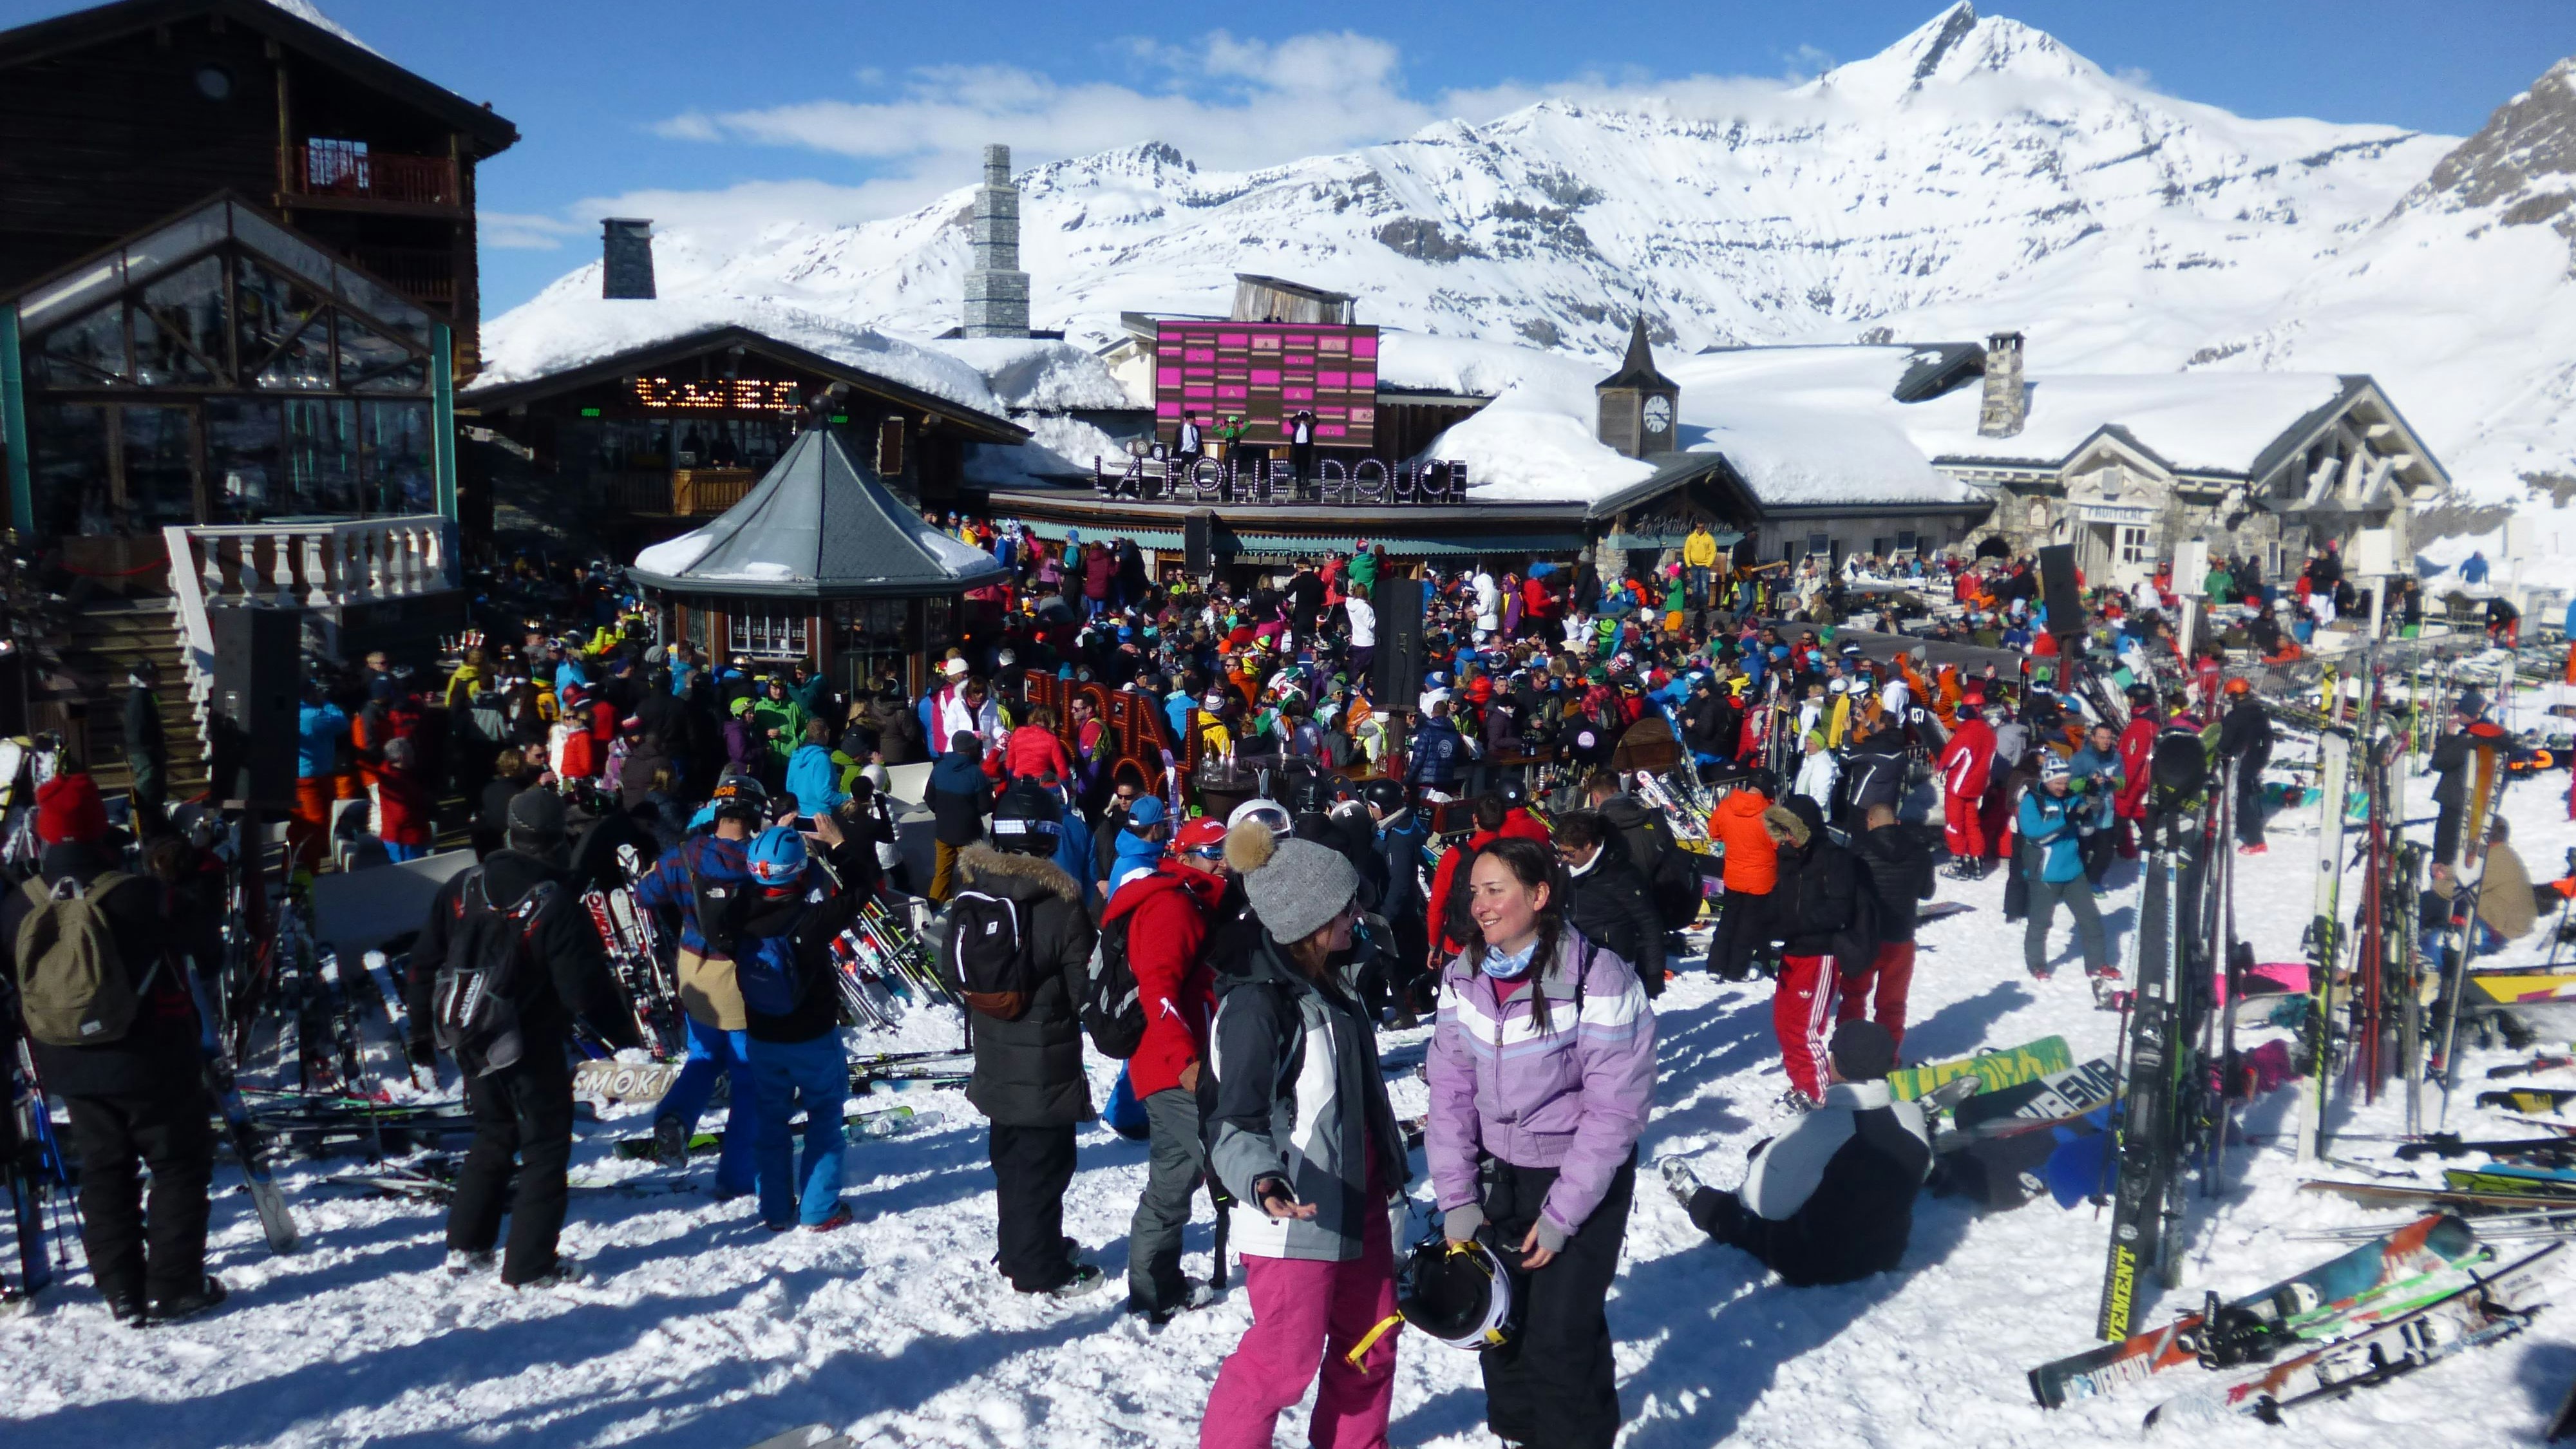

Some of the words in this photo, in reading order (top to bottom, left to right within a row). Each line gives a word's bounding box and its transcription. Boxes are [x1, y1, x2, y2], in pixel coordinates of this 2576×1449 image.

[1094, 455, 1142, 492] LA
[1166, 457, 1288, 495] FOLIE
[1320, 458, 1466, 496] DOUCE
[572, 1069, 681, 1096] SMOKI
